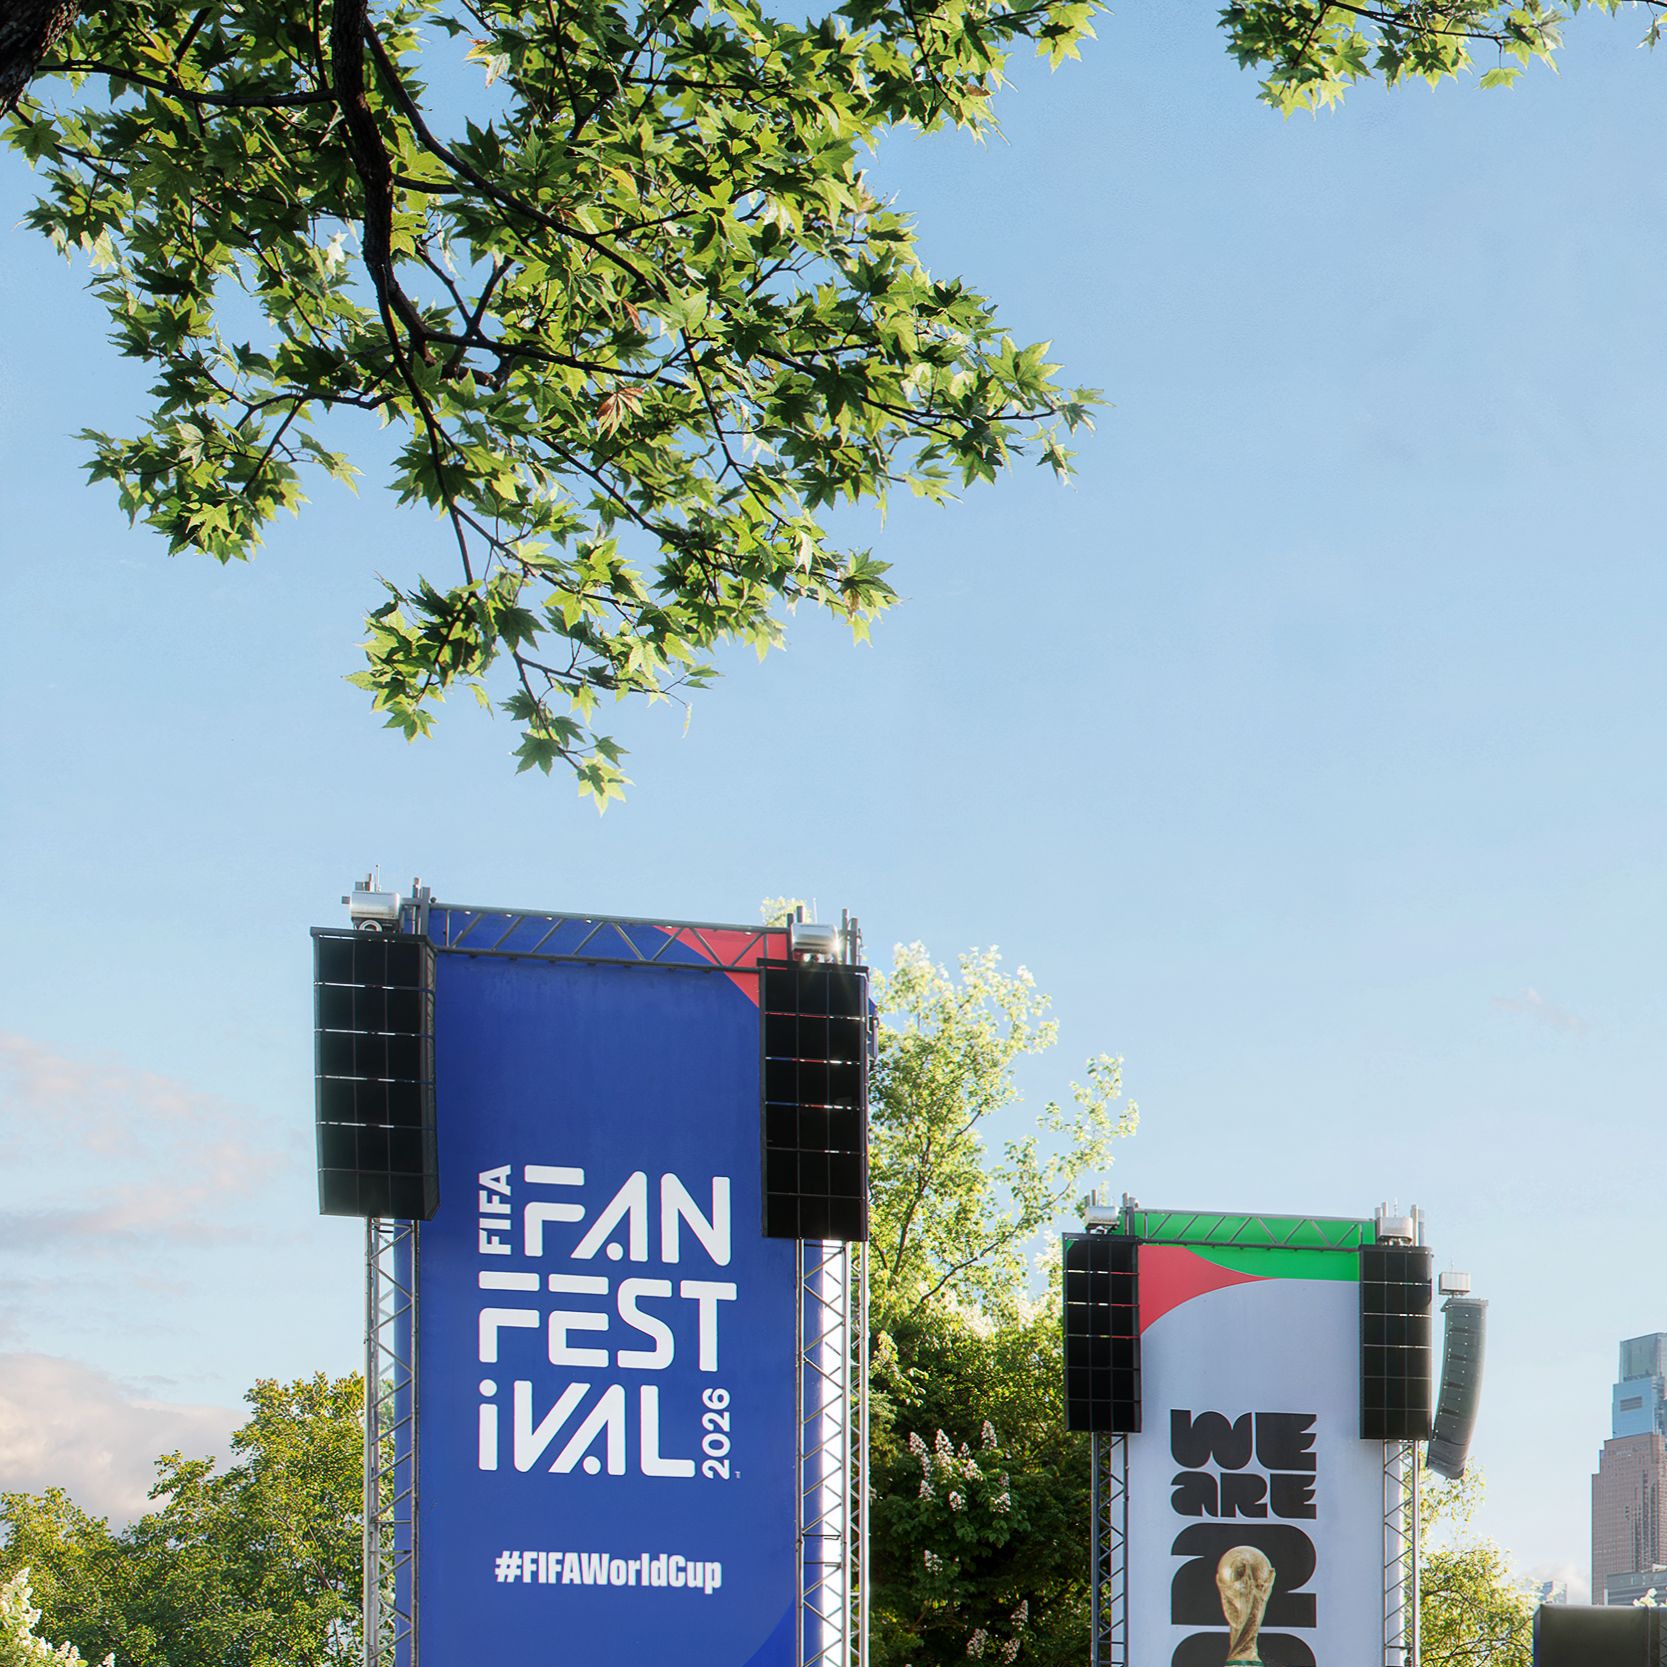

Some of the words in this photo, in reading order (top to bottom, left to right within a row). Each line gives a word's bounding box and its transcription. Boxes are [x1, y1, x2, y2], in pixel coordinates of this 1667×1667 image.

[479, 1164, 512, 1255] FIFA
[523, 1164, 732, 1266] FAN
[478, 1270, 737, 1372] FEST
[702, 1387, 731, 1480] 2026
[1170, 1409, 1317, 1472] WE
[494, 1549, 723, 1595] #FIFAWorldCup
[1170, 1522, 1317, 1628] 2
